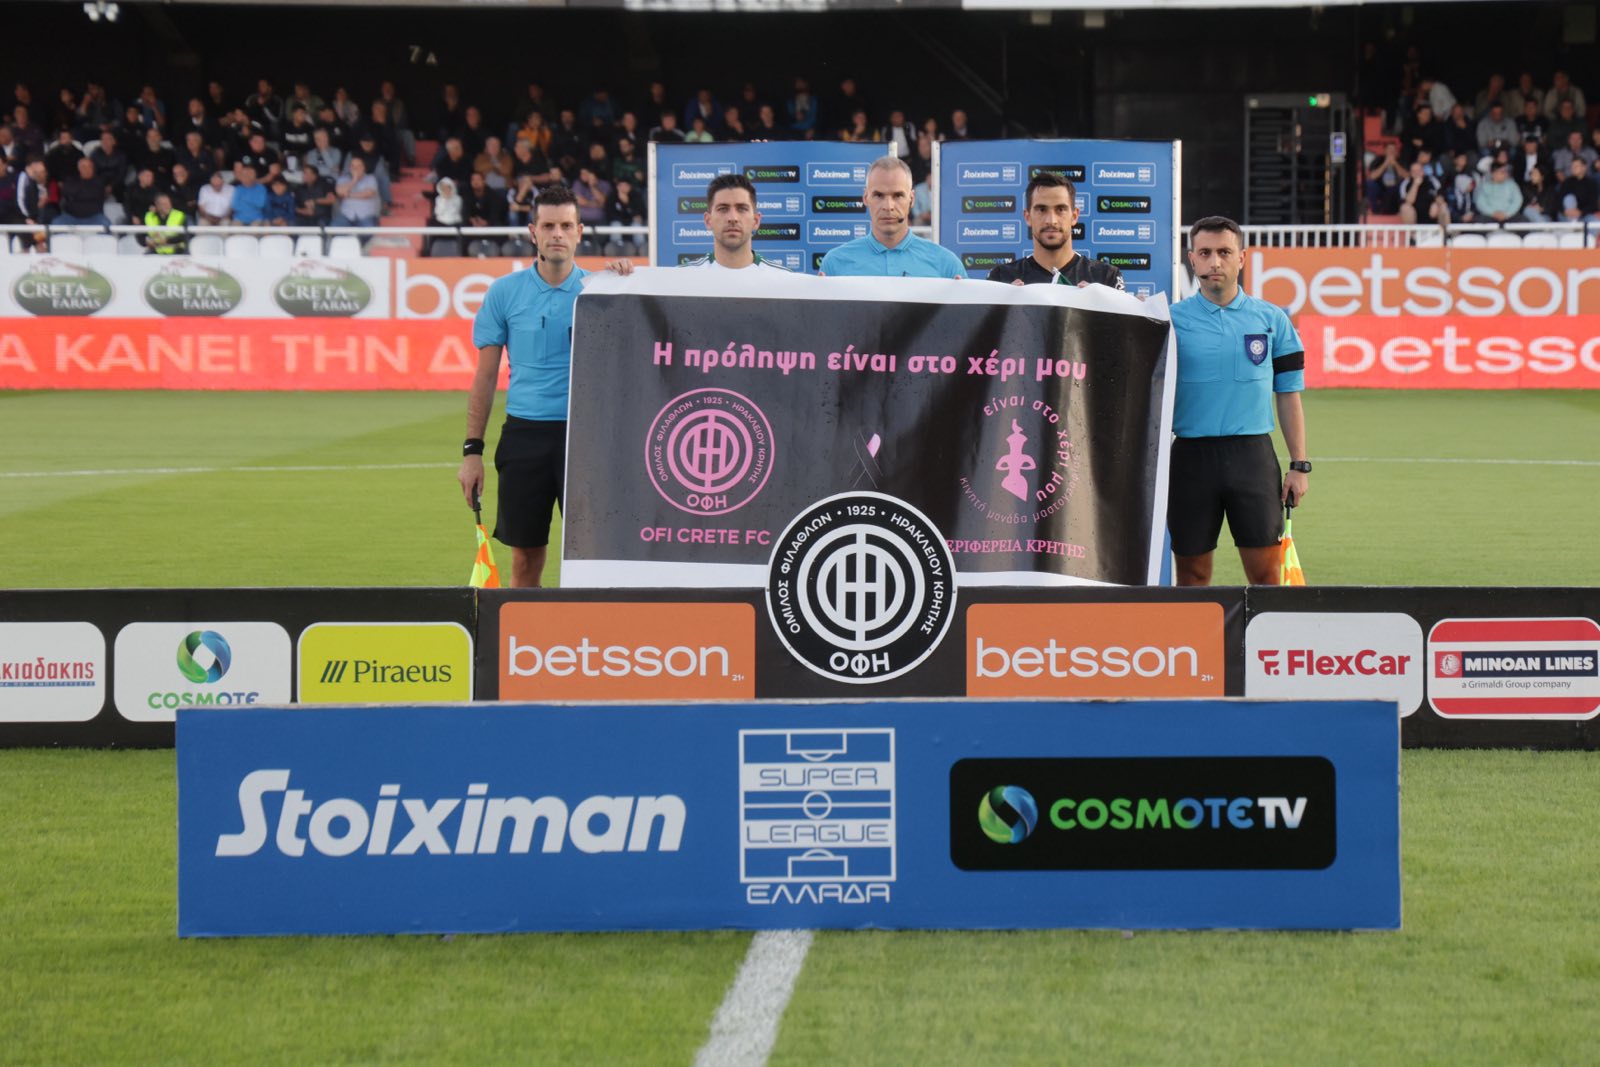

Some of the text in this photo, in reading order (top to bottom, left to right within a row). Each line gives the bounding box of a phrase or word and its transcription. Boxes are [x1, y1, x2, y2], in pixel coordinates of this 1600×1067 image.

[18, 279, 90, 299] CRETA
[149, 279, 220, 299] CRETA
[281, 280, 352, 299] CRETA
[55, 334, 250, 373] ΚΑΝΕΙ
[272, 335, 408, 373] ΤΗΝ
[684, 341, 816, 375] πρόληψη
[827, 344, 896, 372] είναι
[908, 355, 957, 374] στο
[967, 349, 1025, 382] χέρι
[1036, 358, 1087, 382] μου
[703, 396, 723, 405] 1925
[983, 395, 1073, 501] είναι στο χέρι μου
[686, 494, 727, 511] ΟΦΗ
[640, 527, 771, 545] OFI CRETE FC
[946, 540, 1085, 558] ΕΡΙΦΕΡΕΙΑ ΚΡΗΤΗΣ
[778, 505, 944, 635] ΟΜΙΛΟΣ ΦΙΛΑΘΛΩΝ 1925 ΗΡΑΚΛΕΙΟΥ ΚΡΗΤΗΣ
[508, 635, 728, 677] betsson
[829, 651, 890, 676] ΟΦΗ
[976, 637, 1198, 678] betsson
[1287, 649, 1411, 676] FlexCar
[1465, 656, 1594, 671] MINOAN LINES
[354, 660, 452, 684] Piraeus
[1468, 679, 1503, 689] Grimaldi
[1505, 680, 1531, 690] Group
[1533, 681, 1571, 690] company
[759, 767, 878, 787] SUPER
[214, 769, 687, 857] Stoiximan
[746, 824, 889, 844] LEAGUE
